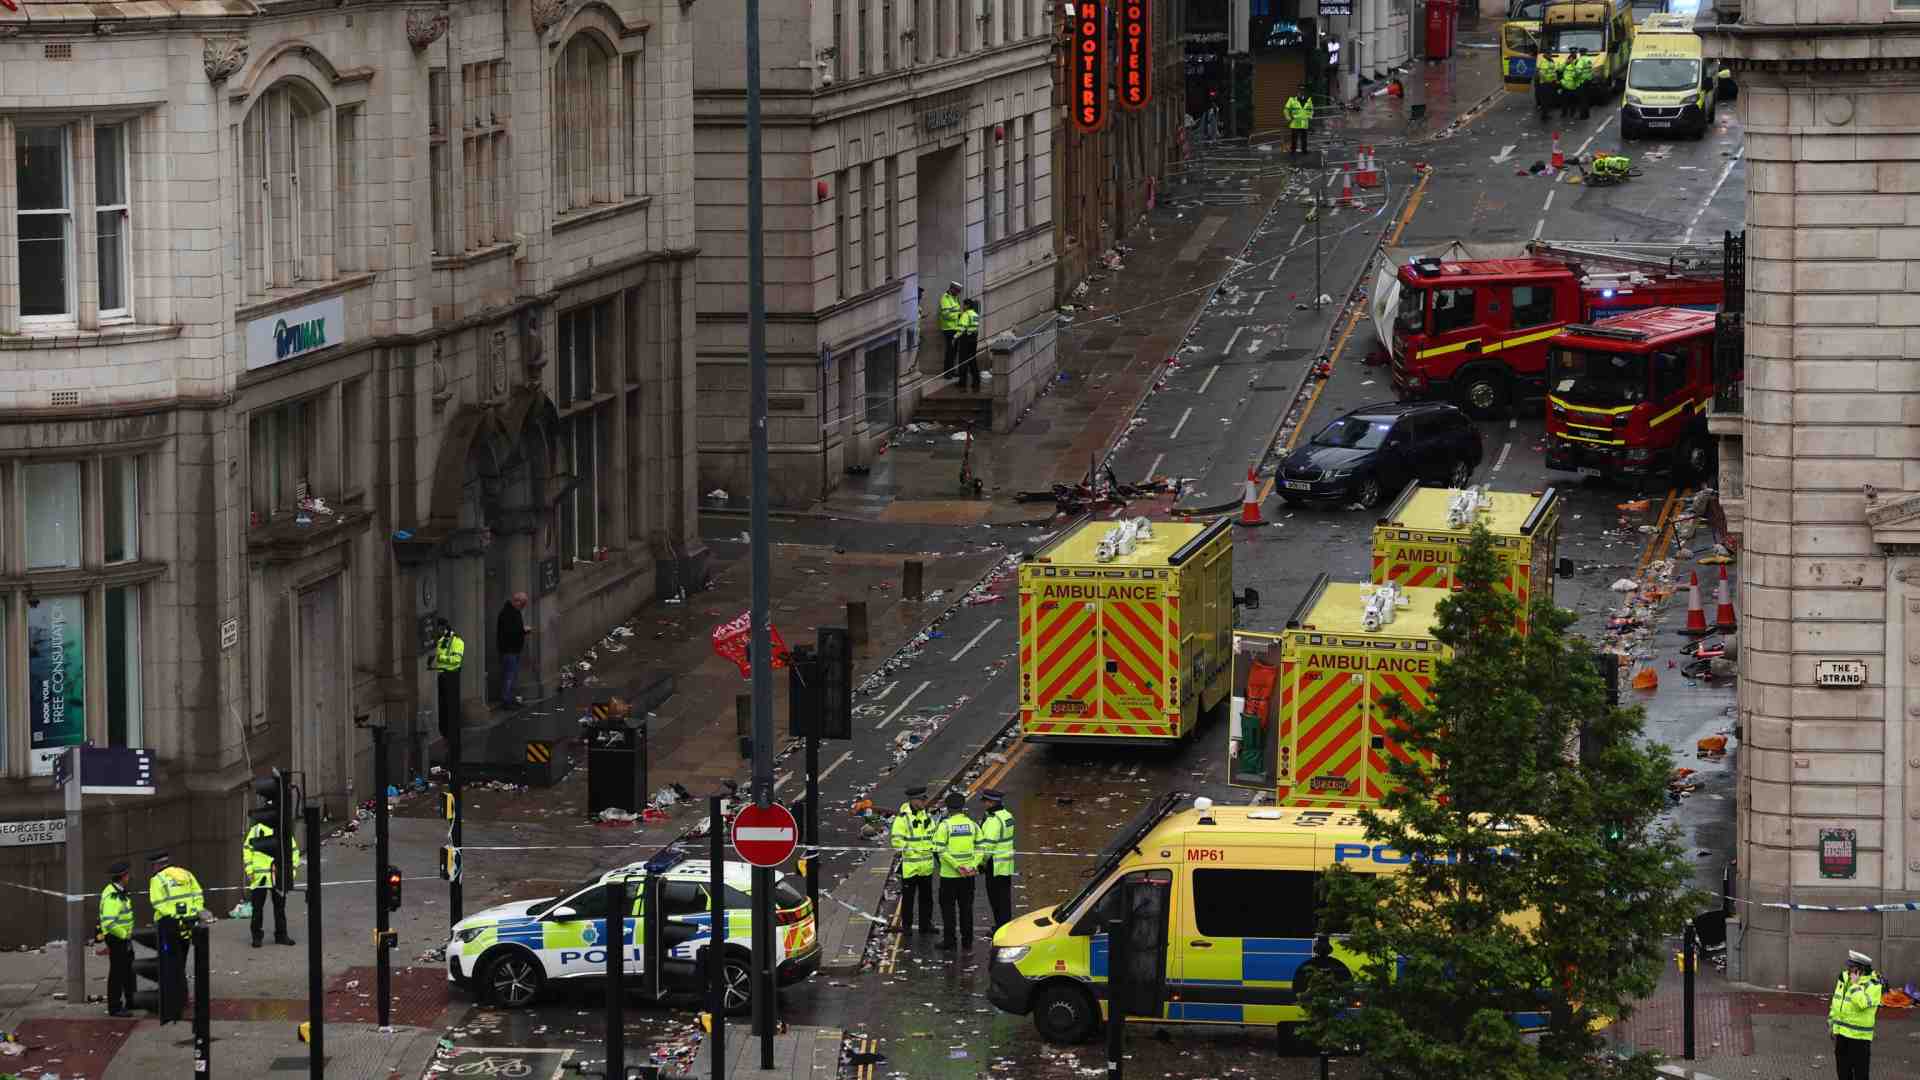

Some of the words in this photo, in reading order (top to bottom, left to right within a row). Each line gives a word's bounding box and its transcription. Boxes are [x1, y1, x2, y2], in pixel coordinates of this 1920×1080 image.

[1128, 0, 1141, 102] OOTERS
[1082, 3, 1096, 123] HOOTERS
[1044, 584, 1157, 600] AMBULANCE
[1307, 653, 1430, 673] AMBULANCE
[1832, 663, 1850, 672] THE
[1823, 674, 1859, 683] STRAND
[53, 696, 65, 723] FREE
[0, 822, 45, 834] EORGES
[19, 832, 53, 843] GATES
[1188, 849, 1223, 861] MP61
